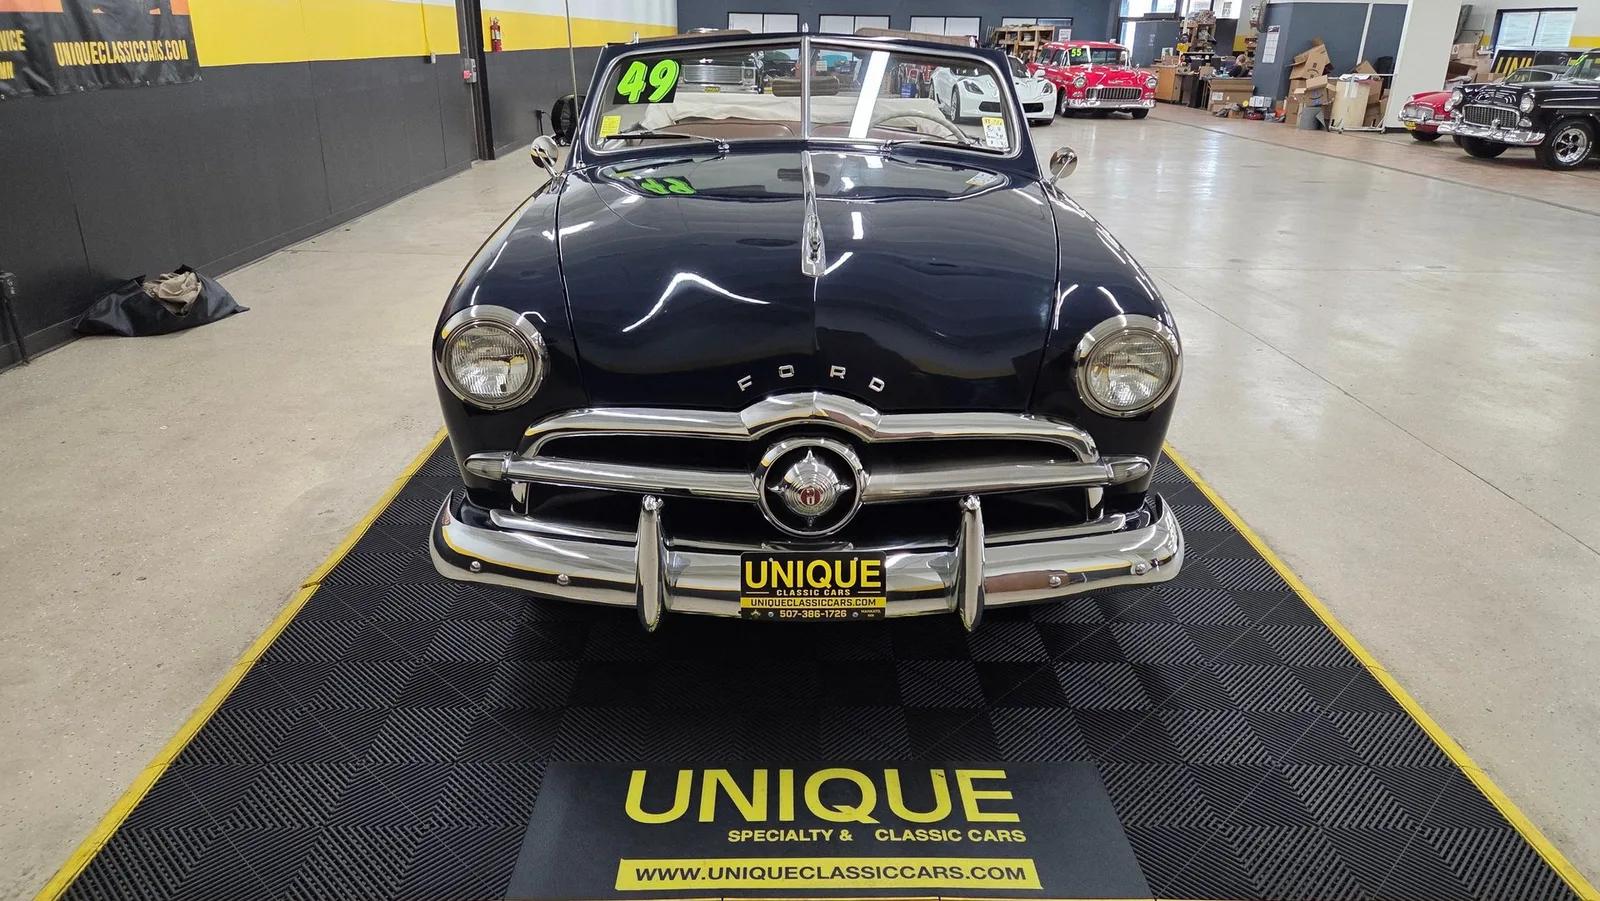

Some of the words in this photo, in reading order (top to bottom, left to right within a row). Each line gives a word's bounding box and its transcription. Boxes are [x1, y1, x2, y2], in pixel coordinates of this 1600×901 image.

[53, 40, 189, 67] UNIQUECLASSICCARS.COM
[616, 59, 680, 104] 49
[736, 364, 885, 393] FORD
[745, 559, 882, 589] UNIQUE
[750, 598, 876, 608] UNIQUECLASSICCARS.COM
[776, 589, 820, 597] CLASSIC
[824, 588, 851, 596] CARS
[779, 609, 848, 618] 507-386-1726
[625, 768, 1021, 825] UNIQUE
[727, 829, 834, 843] SPECIALTY
[839, 829, 853, 842] &
[875, 828, 963, 842] CLASSIC
[967, 829, 1027, 843] CARS
[635, 865, 1027, 882] WWW.UNIQUECLASSICCARS.COM
